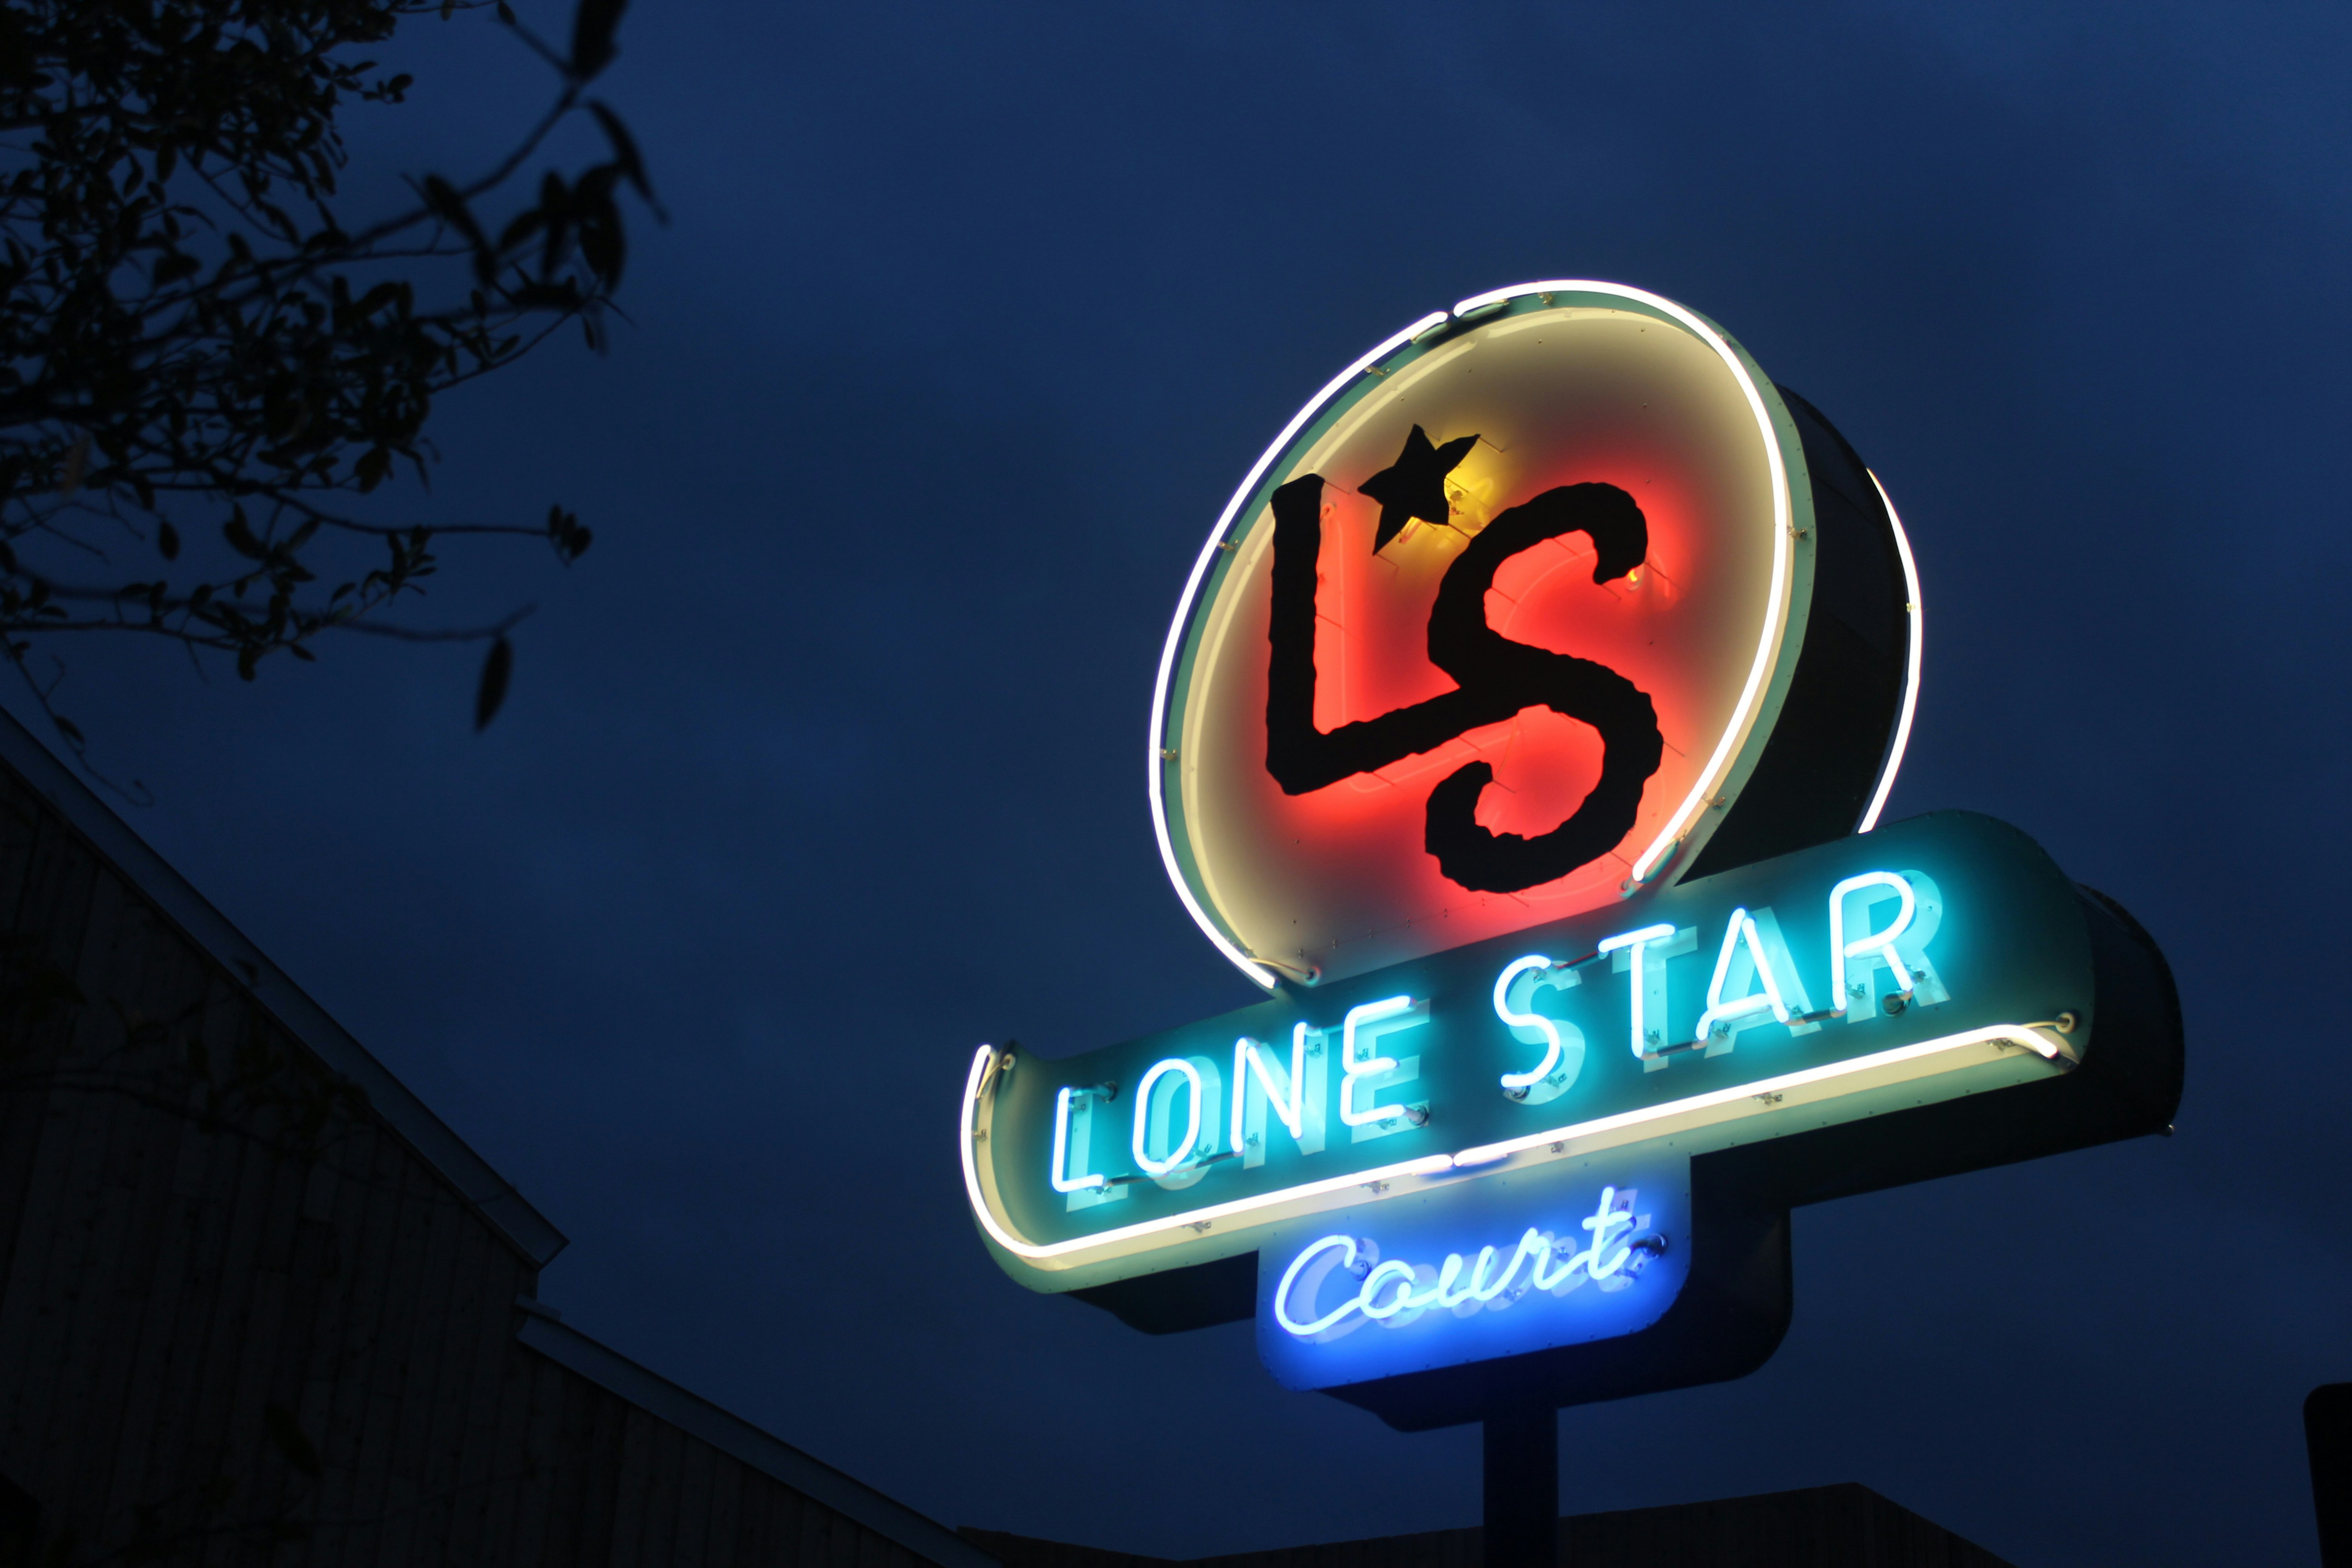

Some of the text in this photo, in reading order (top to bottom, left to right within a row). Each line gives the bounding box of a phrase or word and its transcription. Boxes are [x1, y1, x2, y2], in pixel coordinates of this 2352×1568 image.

[1051, 869, 1950, 1212] LONE STAR
[1275, 1186, 1650, 1343] Court
